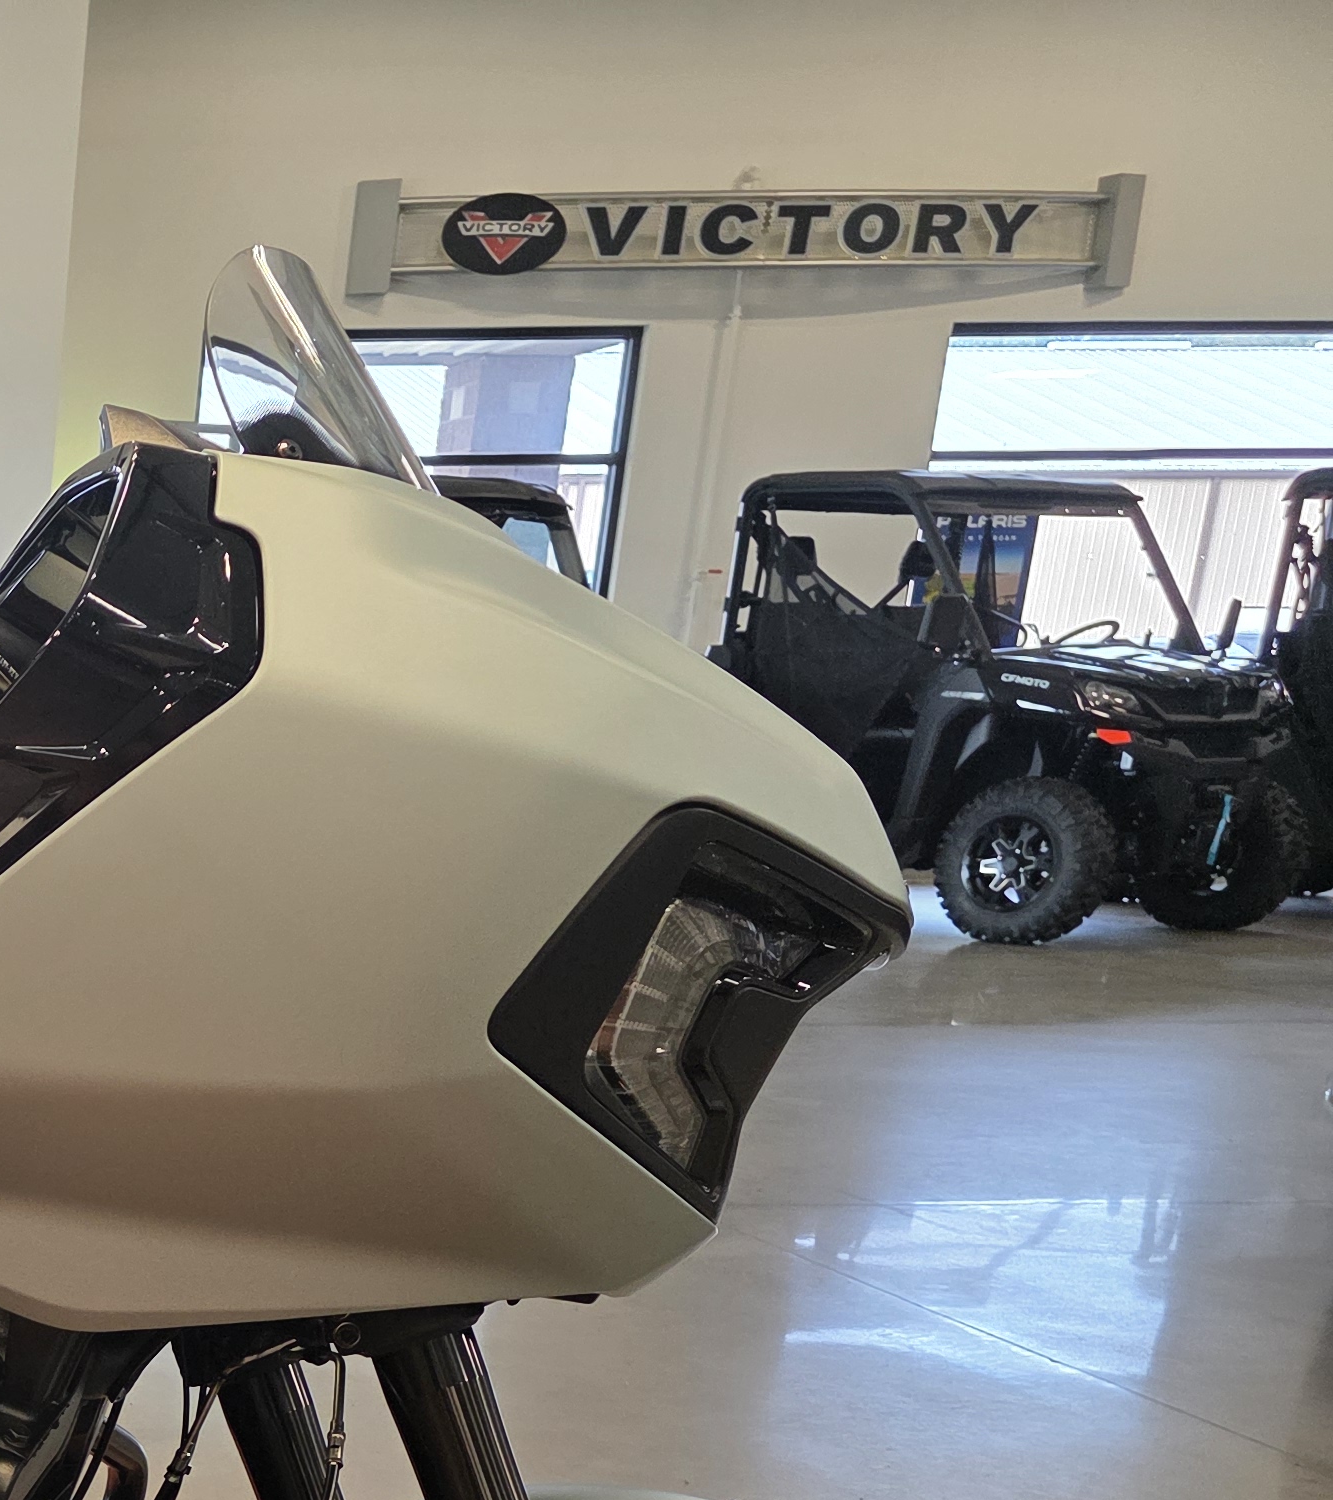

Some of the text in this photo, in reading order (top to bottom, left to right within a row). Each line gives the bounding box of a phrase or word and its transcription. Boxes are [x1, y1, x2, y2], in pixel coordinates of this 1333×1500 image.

[461, 221, 550, 234] VICTORY
[585, 202, 1040, 256] VICTORY
[936, 514, 1028, 528] PLARIS
